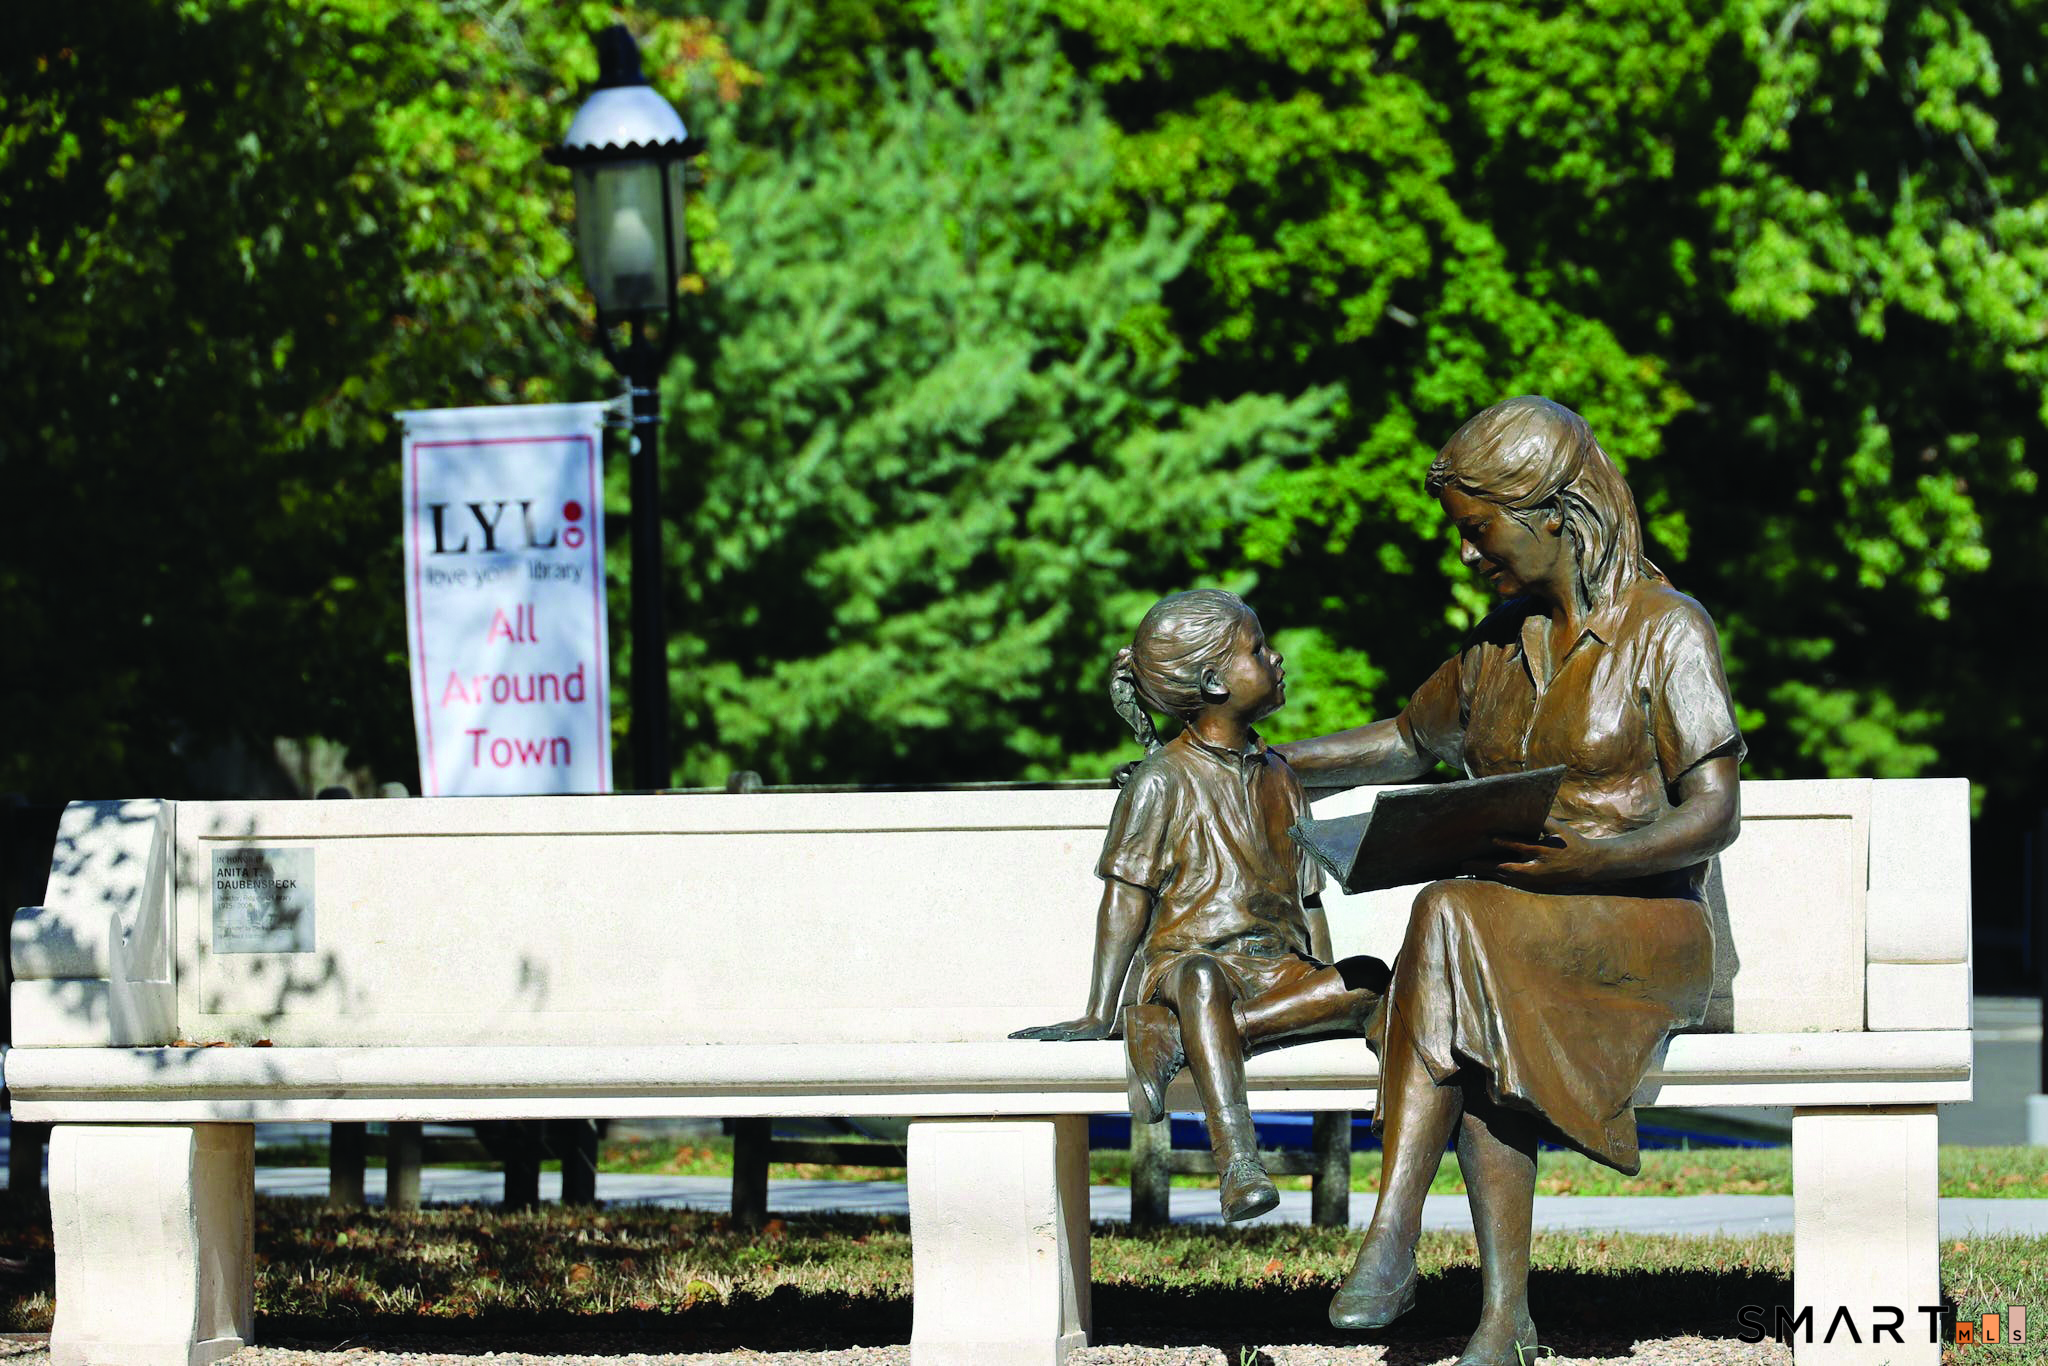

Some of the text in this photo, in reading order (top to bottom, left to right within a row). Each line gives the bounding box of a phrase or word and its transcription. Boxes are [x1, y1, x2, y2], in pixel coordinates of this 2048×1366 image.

[425, 566, 467, 585] love
[528, 559, 584, 584] library
[488, 602, 539, 645] All
[441, 661, 587, 708] Around
[465, 728, 572, 768] Town
[216, 867, 249, 878] ANITA
[217, 880, 297, 890] DAUBENSPECK
